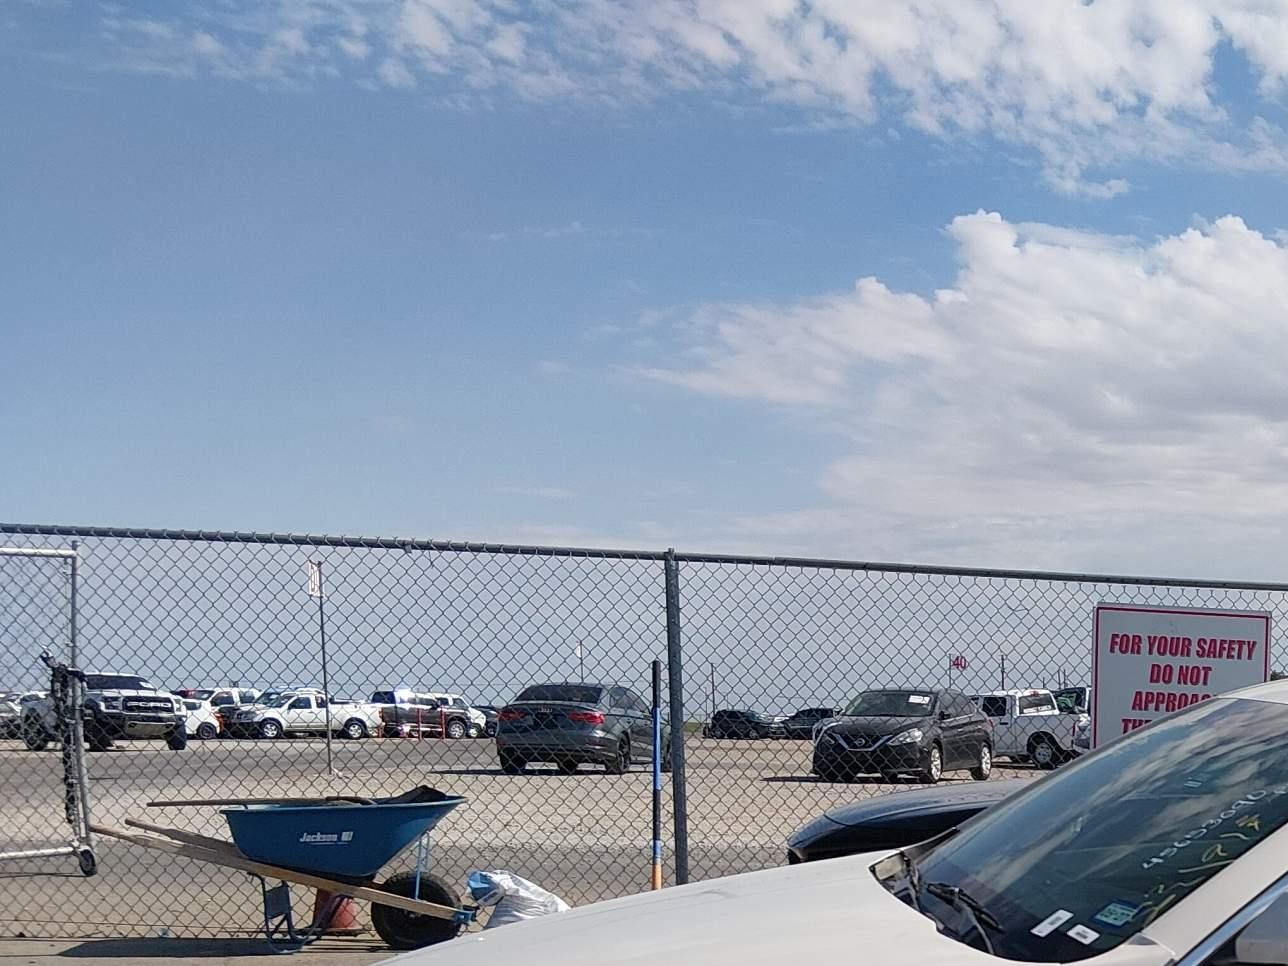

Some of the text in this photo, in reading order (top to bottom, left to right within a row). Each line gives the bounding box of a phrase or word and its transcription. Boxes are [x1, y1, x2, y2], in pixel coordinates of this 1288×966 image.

[1109, 633, 1257, 660] FOR YOUR SAFETY
[1149, 664, 1212, 686] DO NOT
[299, 832, 338, 842] Jackson
